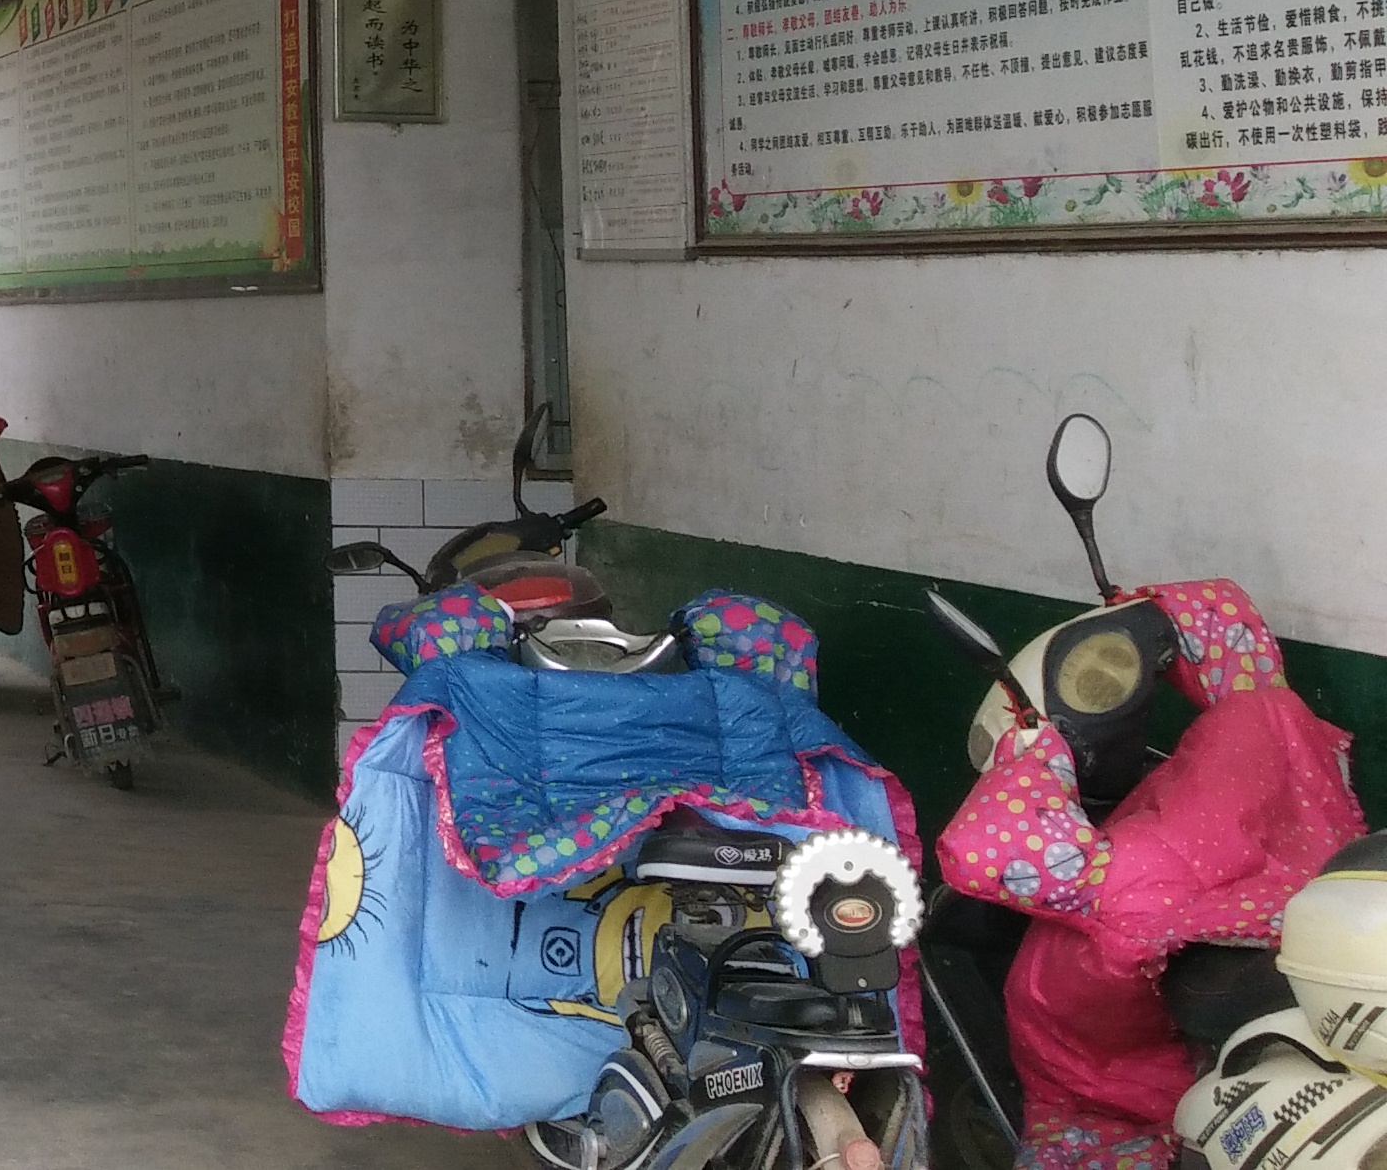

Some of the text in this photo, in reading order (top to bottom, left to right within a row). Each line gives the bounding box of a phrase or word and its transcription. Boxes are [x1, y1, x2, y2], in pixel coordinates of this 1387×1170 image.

[398, 19, 423, 94] 为中华之
[282, 8, 302, 240] 打造平安教育平安校园
[78, 722, 117, 748] 新日
[705, 1061, 764, 1100] PHOENIX
